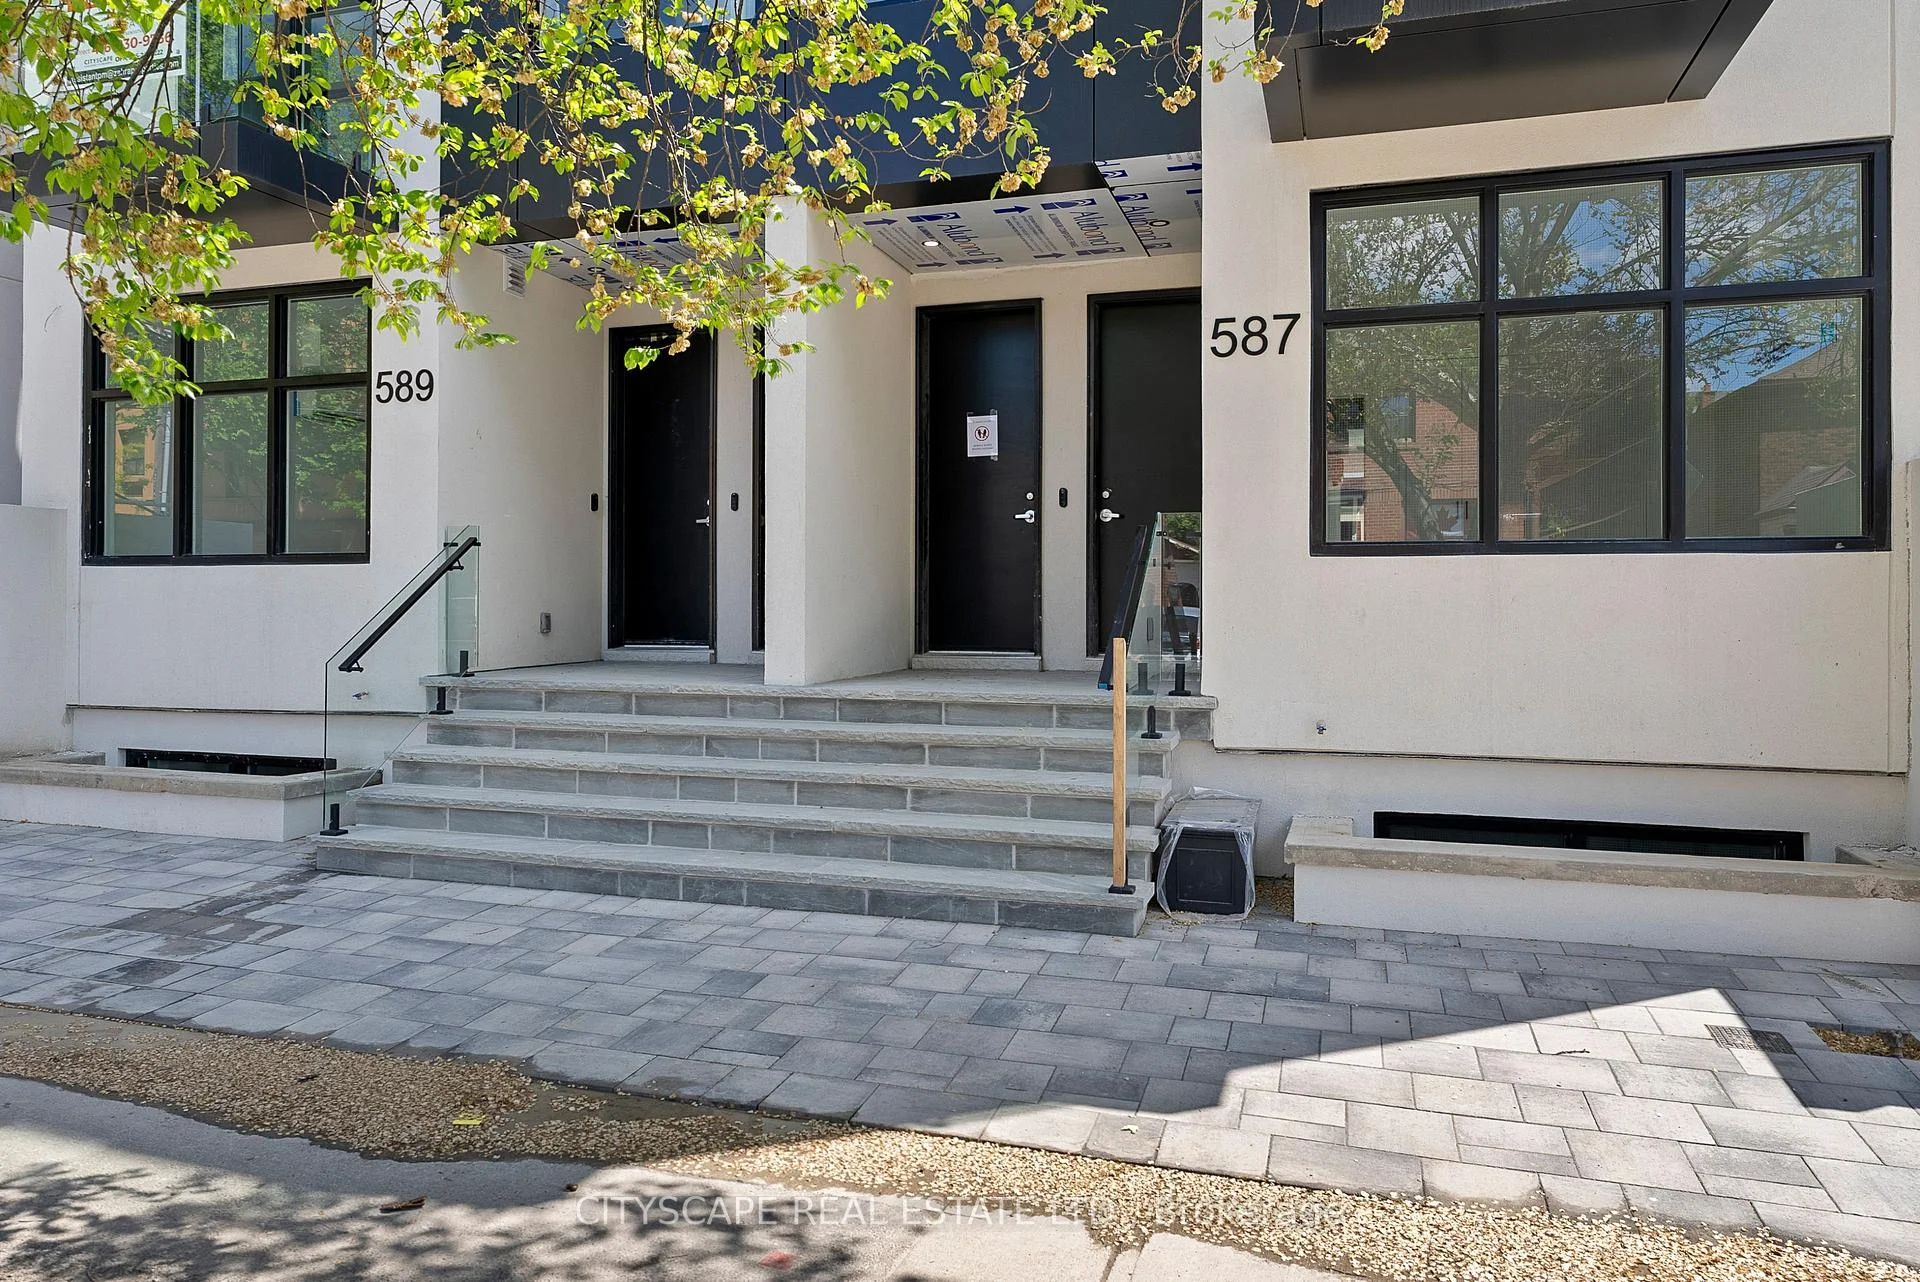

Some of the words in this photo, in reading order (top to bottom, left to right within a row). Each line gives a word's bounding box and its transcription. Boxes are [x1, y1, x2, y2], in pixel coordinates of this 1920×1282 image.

[937, 224, 996, 256] Alubond
[1070, 211, 1122, 246] Alubond
[1210, 314, 1301, 358] 587
[375, 369, 434, 404] 589
